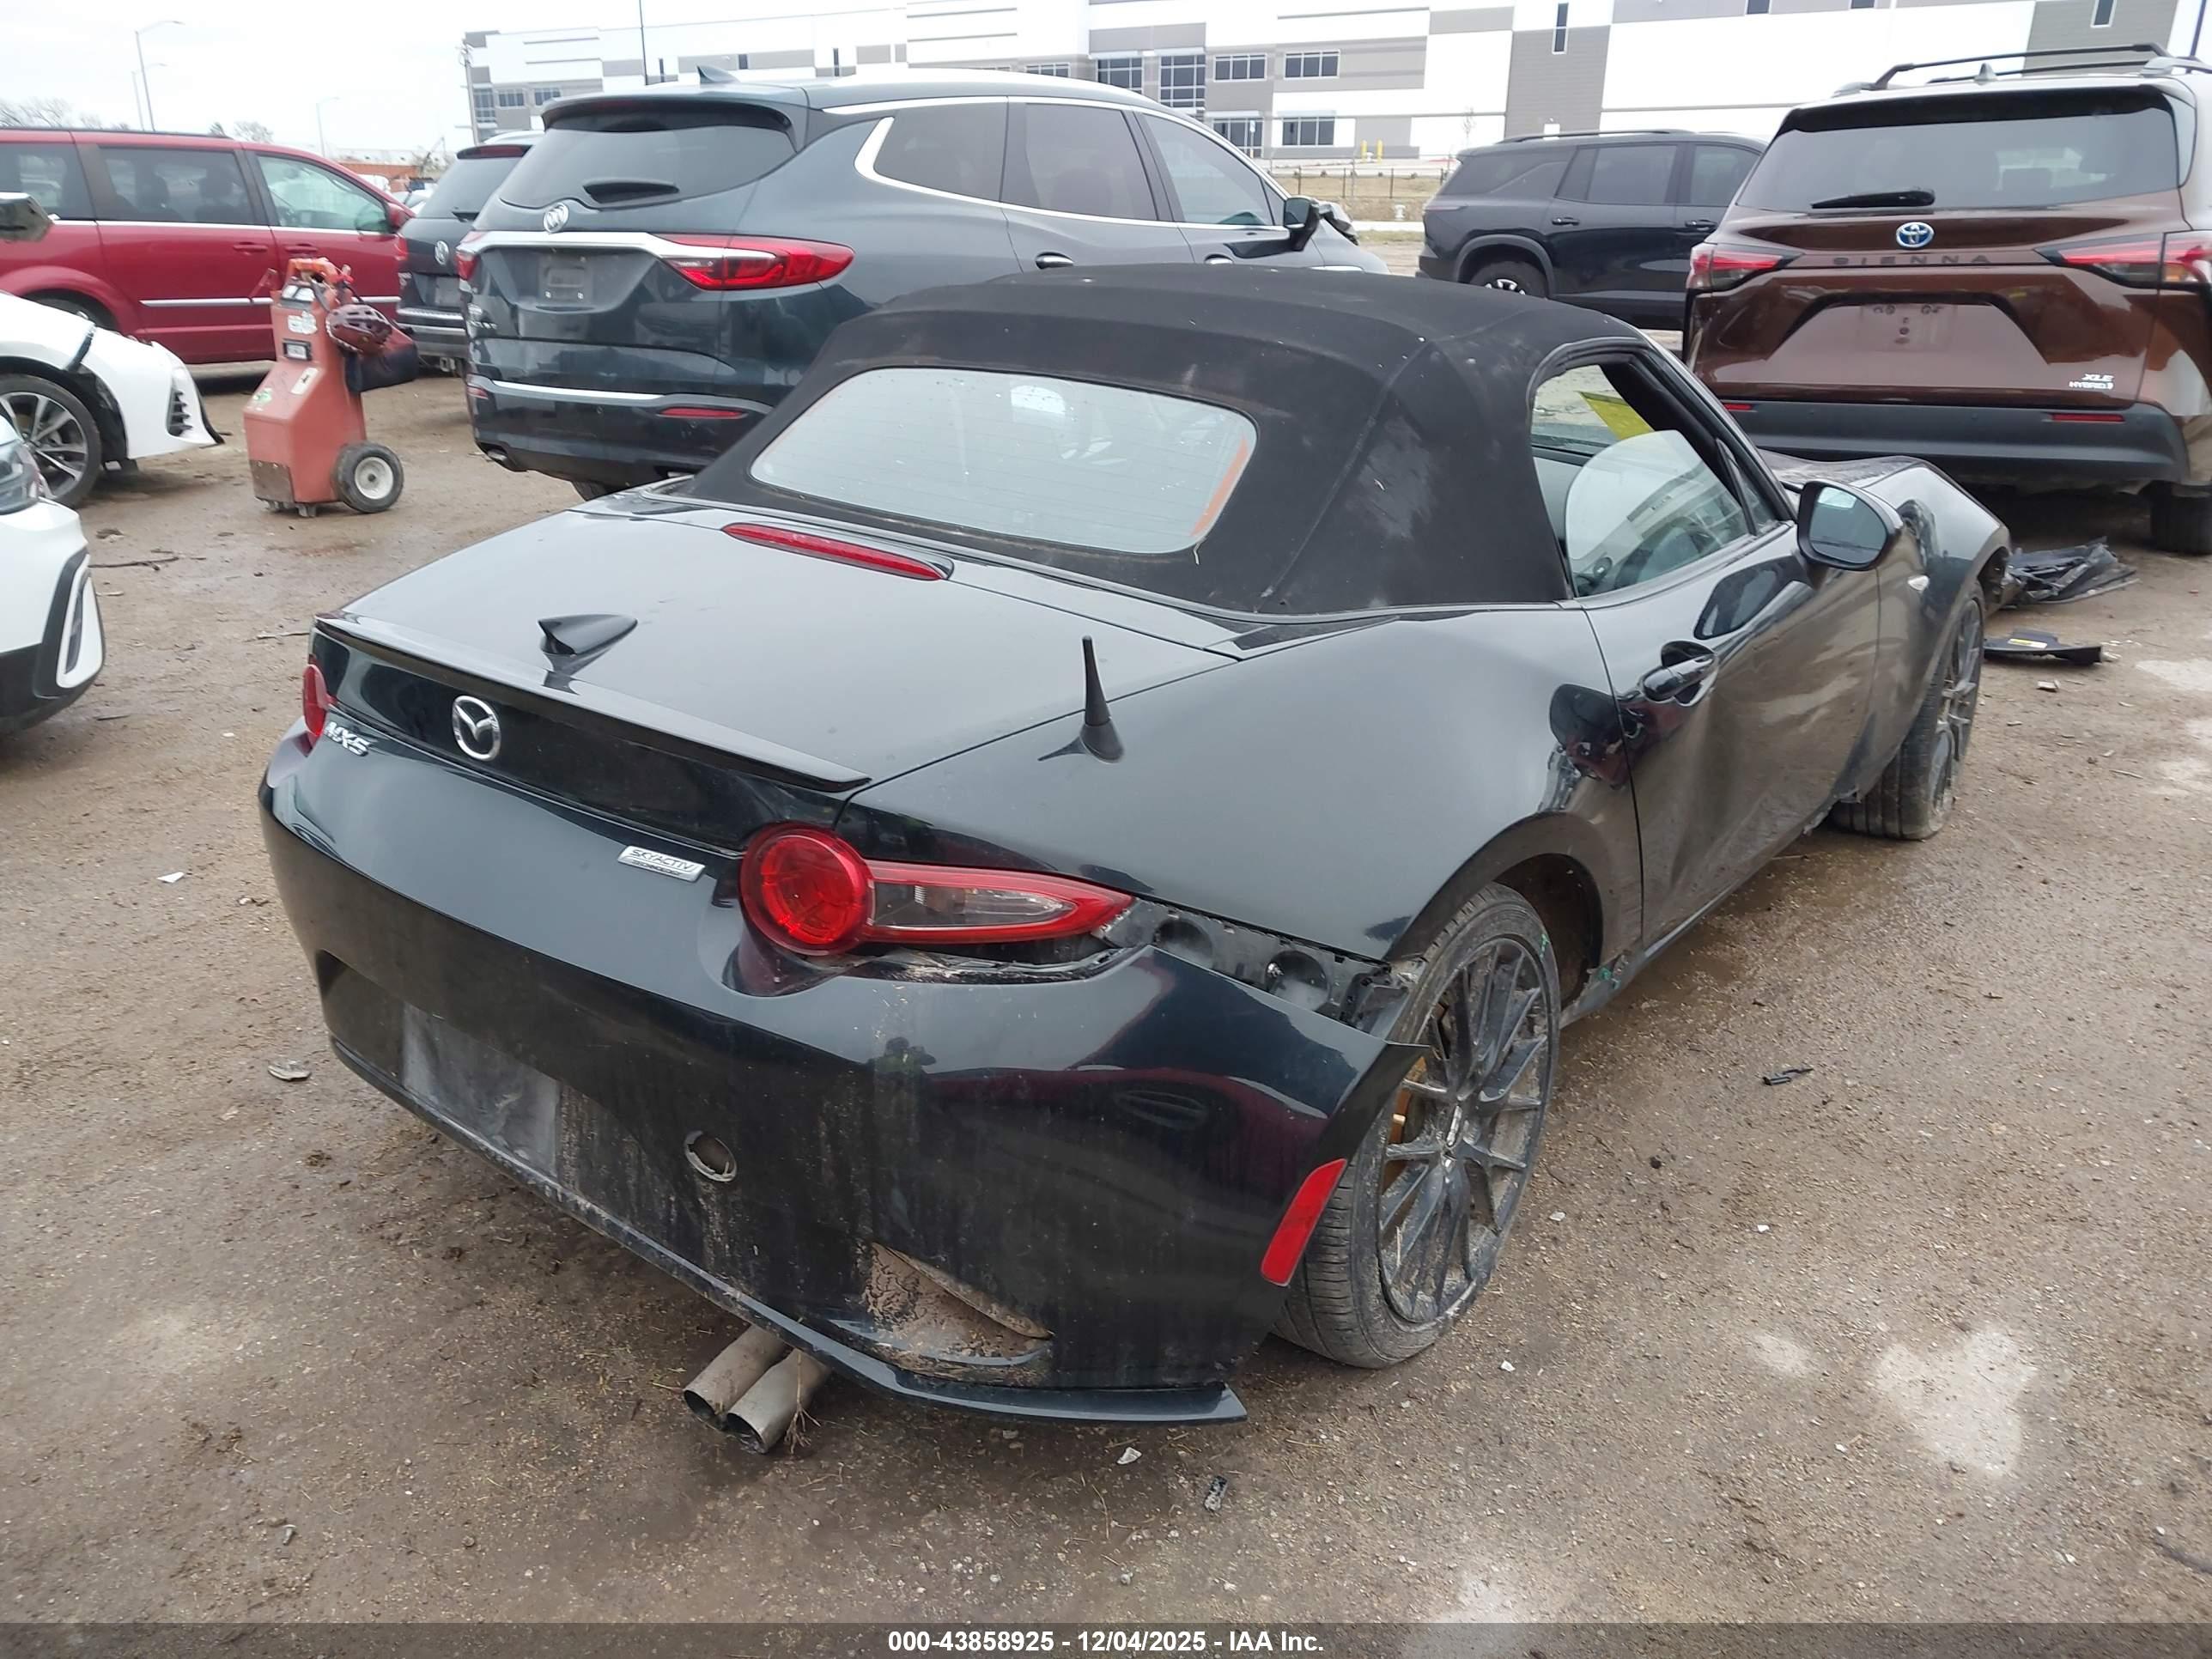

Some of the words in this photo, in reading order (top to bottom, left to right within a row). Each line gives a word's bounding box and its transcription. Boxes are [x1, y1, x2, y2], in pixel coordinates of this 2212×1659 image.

[1833, 254, 1991, 265] SIENNA
[2081, 373, 2114, 381] XLE
[629, 848, 694, 870] SKYACTIV
